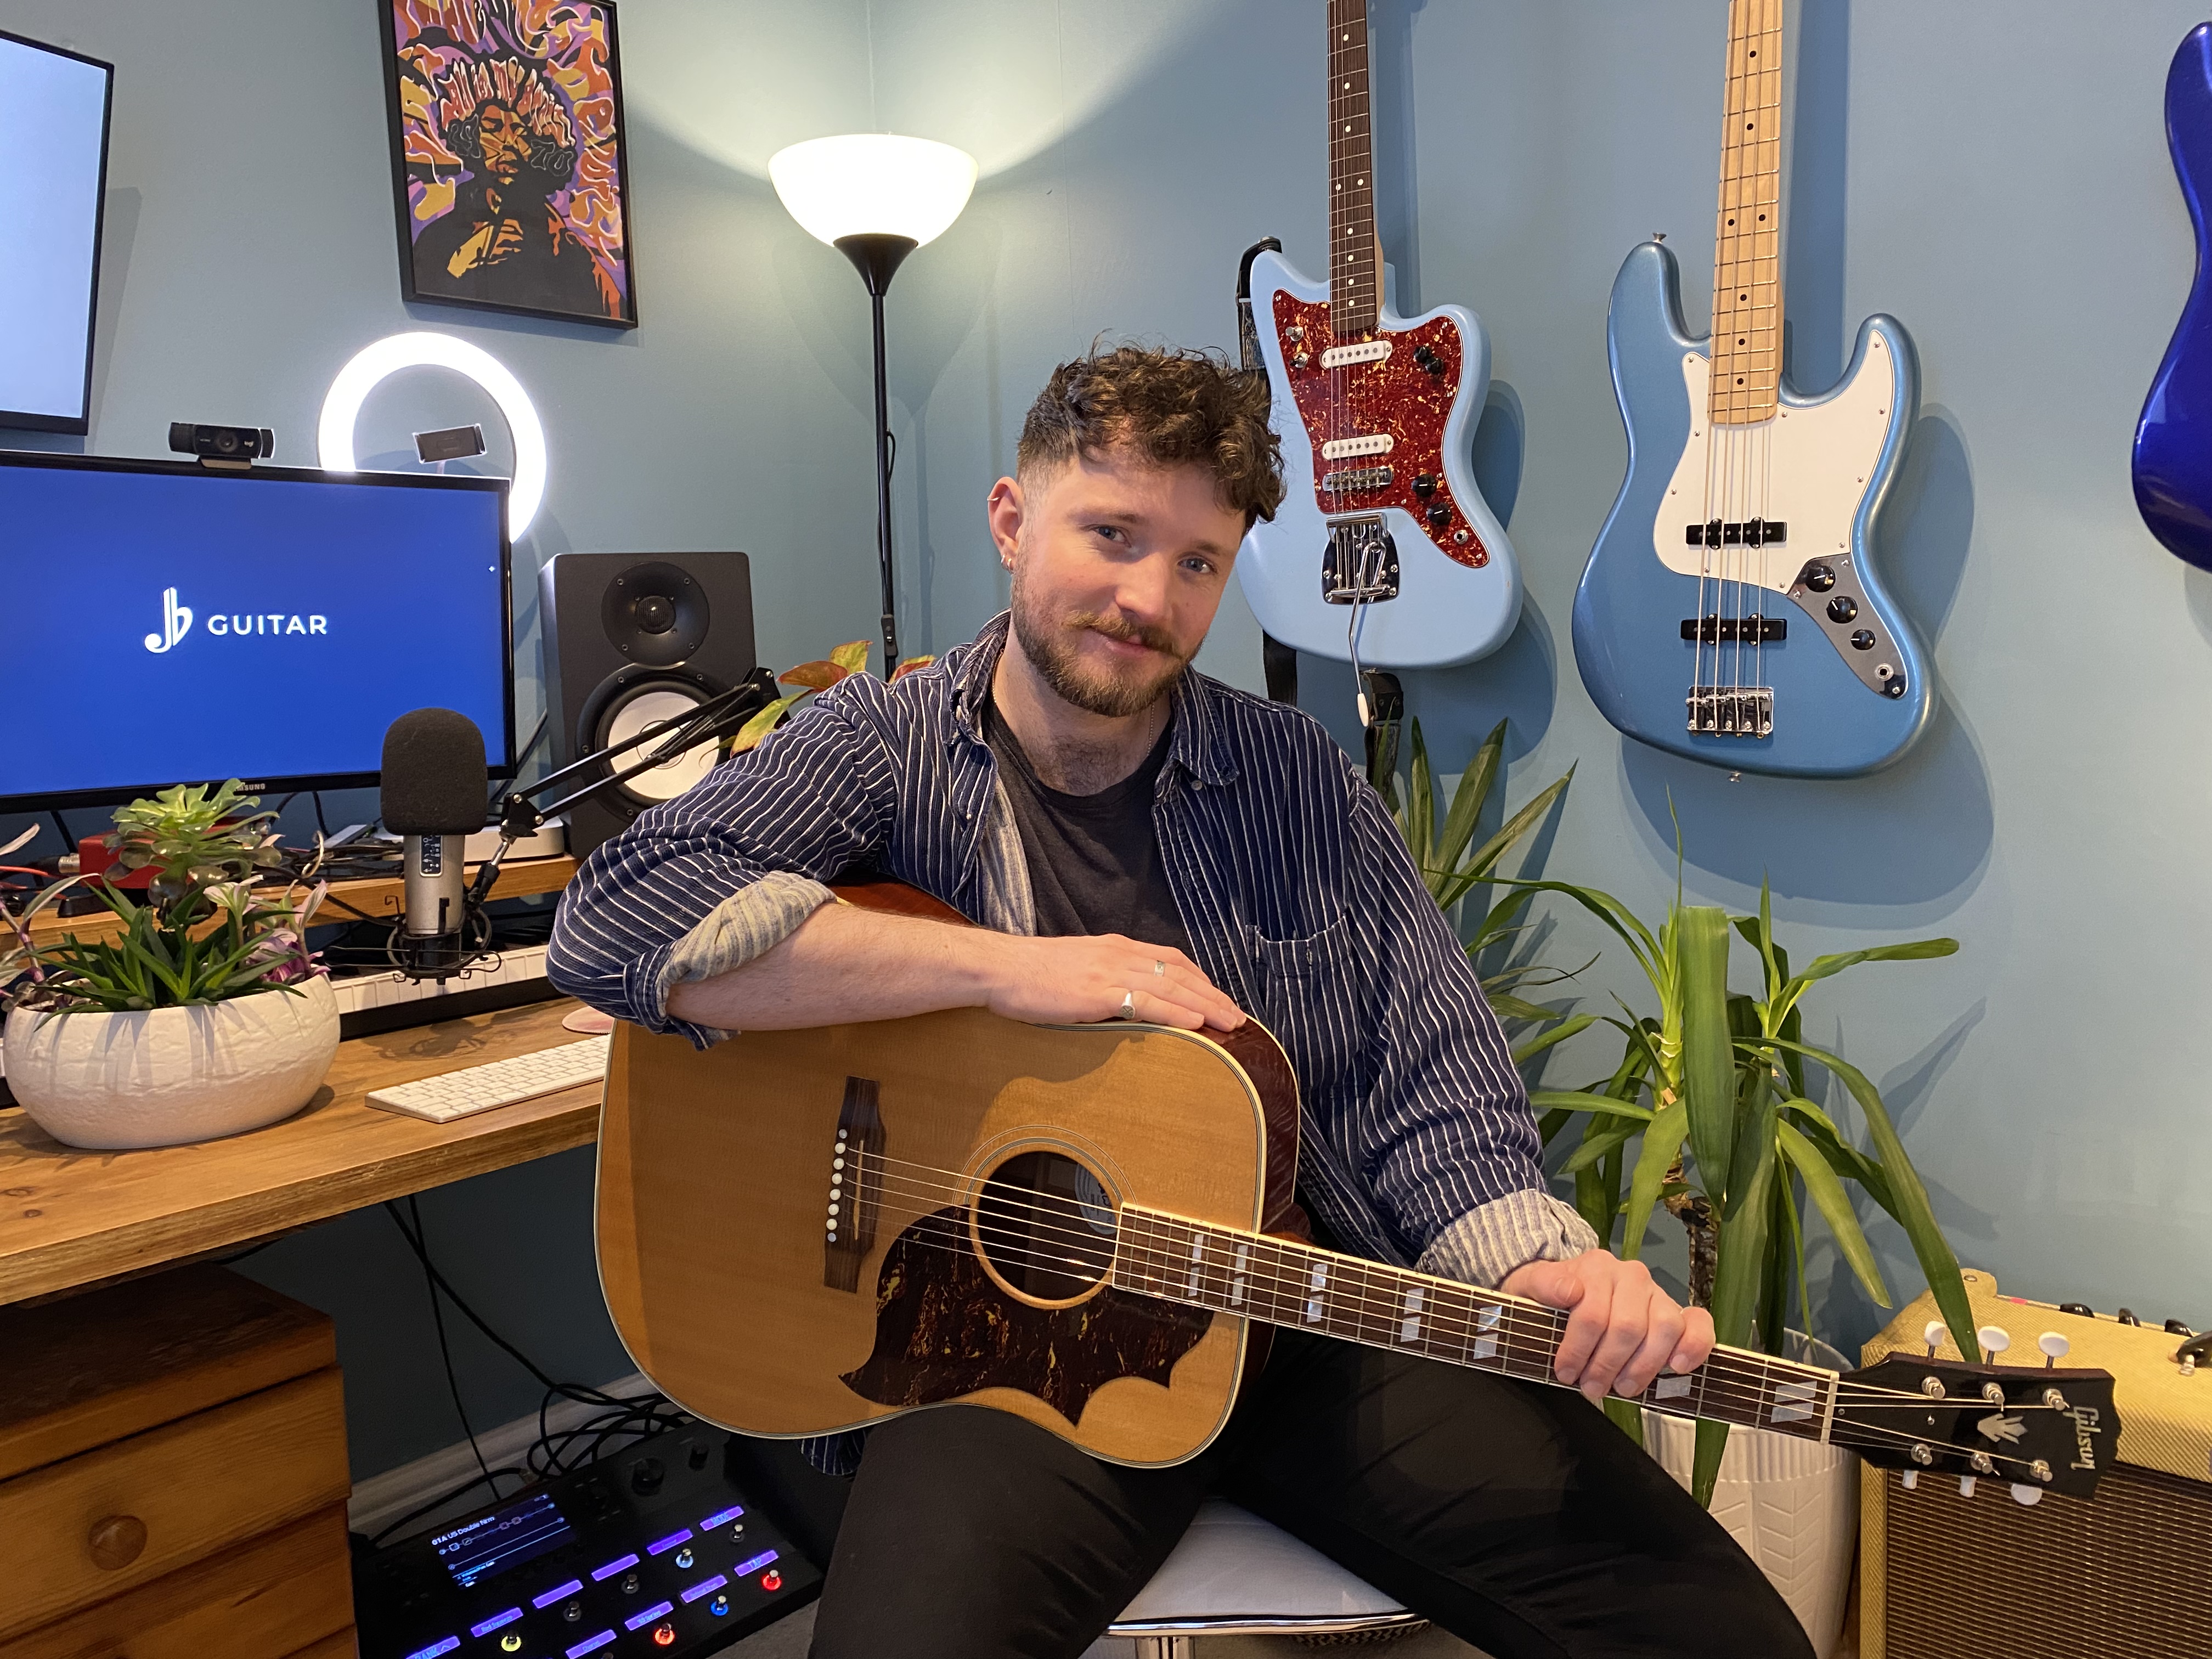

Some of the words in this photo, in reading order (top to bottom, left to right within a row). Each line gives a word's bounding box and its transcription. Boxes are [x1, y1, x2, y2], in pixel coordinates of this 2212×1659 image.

[207, 614, 327, 636] GUITAR
[2063, 1406, 2102, 1470] Gibson
[447, 1531, 458, 1539] US
[747, 1558, 761, 1570] TAP
